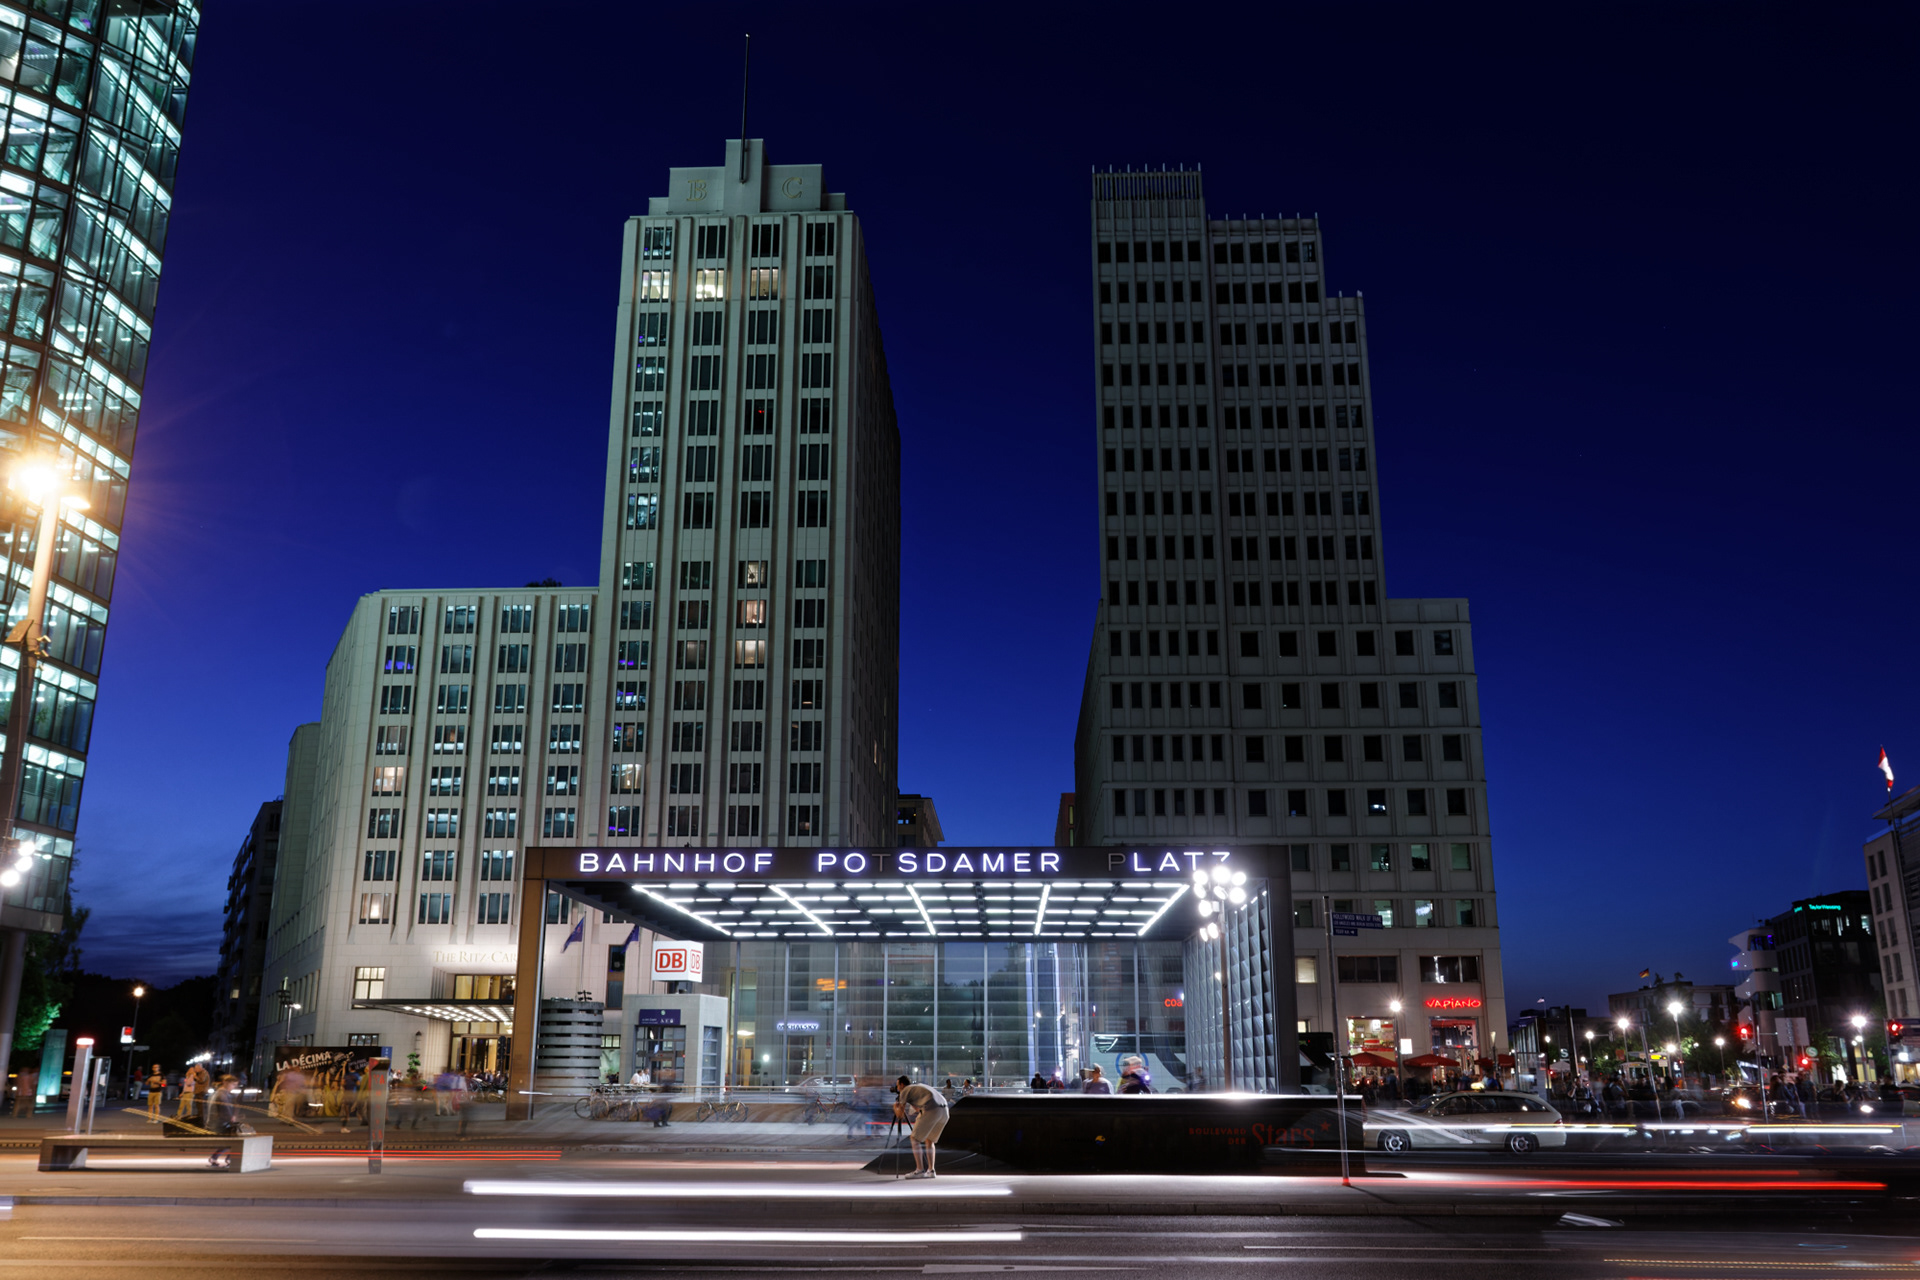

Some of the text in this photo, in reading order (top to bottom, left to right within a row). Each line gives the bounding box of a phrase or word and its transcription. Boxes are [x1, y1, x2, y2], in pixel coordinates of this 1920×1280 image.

[782, 177, 802, 199] C
[579, 852, 772, 873] BAHNHOF
[817, 852, 1060, 873] POTSDAMER
[659, 952, 683, 969] DB
[691, 953, 701, 970] DB
[276, 1059, 290, 1072] LA
[1188, 1127, 1247, 1135] BOULEVARD
[1252, 1122, 1315, 1149] Stars
[1227, 1137, 1247, 1145] DER
